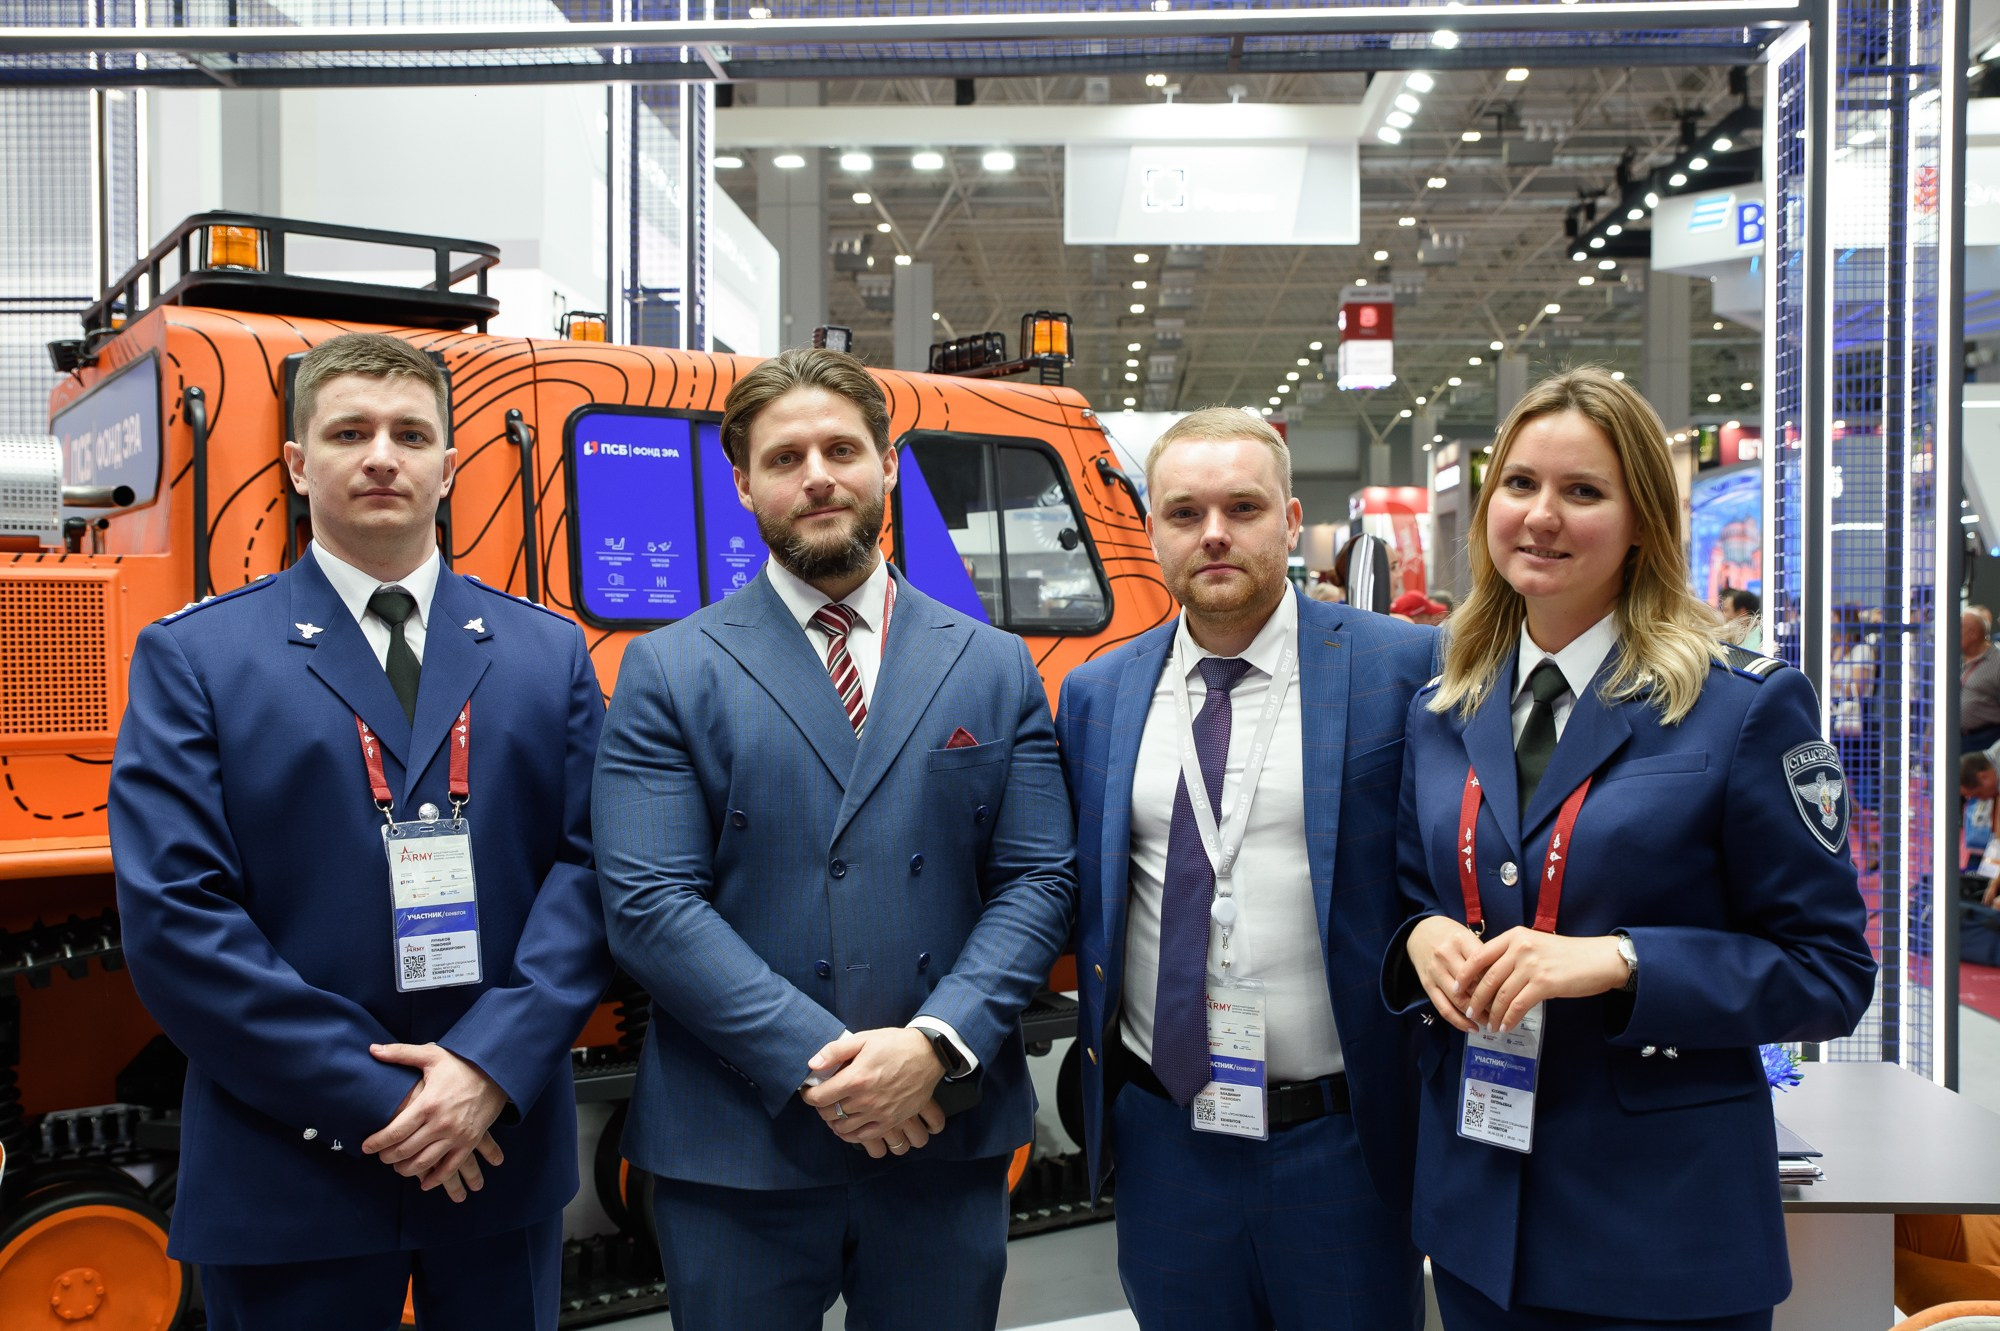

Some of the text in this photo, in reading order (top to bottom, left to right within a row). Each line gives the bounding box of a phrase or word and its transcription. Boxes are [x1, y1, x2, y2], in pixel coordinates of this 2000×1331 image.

[70, 412, 142, 484] ПСБ ФОНД ЭРА
[600, 443, 680, 458] ПСБ ФОНД ЭРА
[1789, 748, 1837, 769] СПЕЦСВЯЗЬ
[399, 845, 433, 863] ARMY
[404, 943, 424, 953] ARMY
